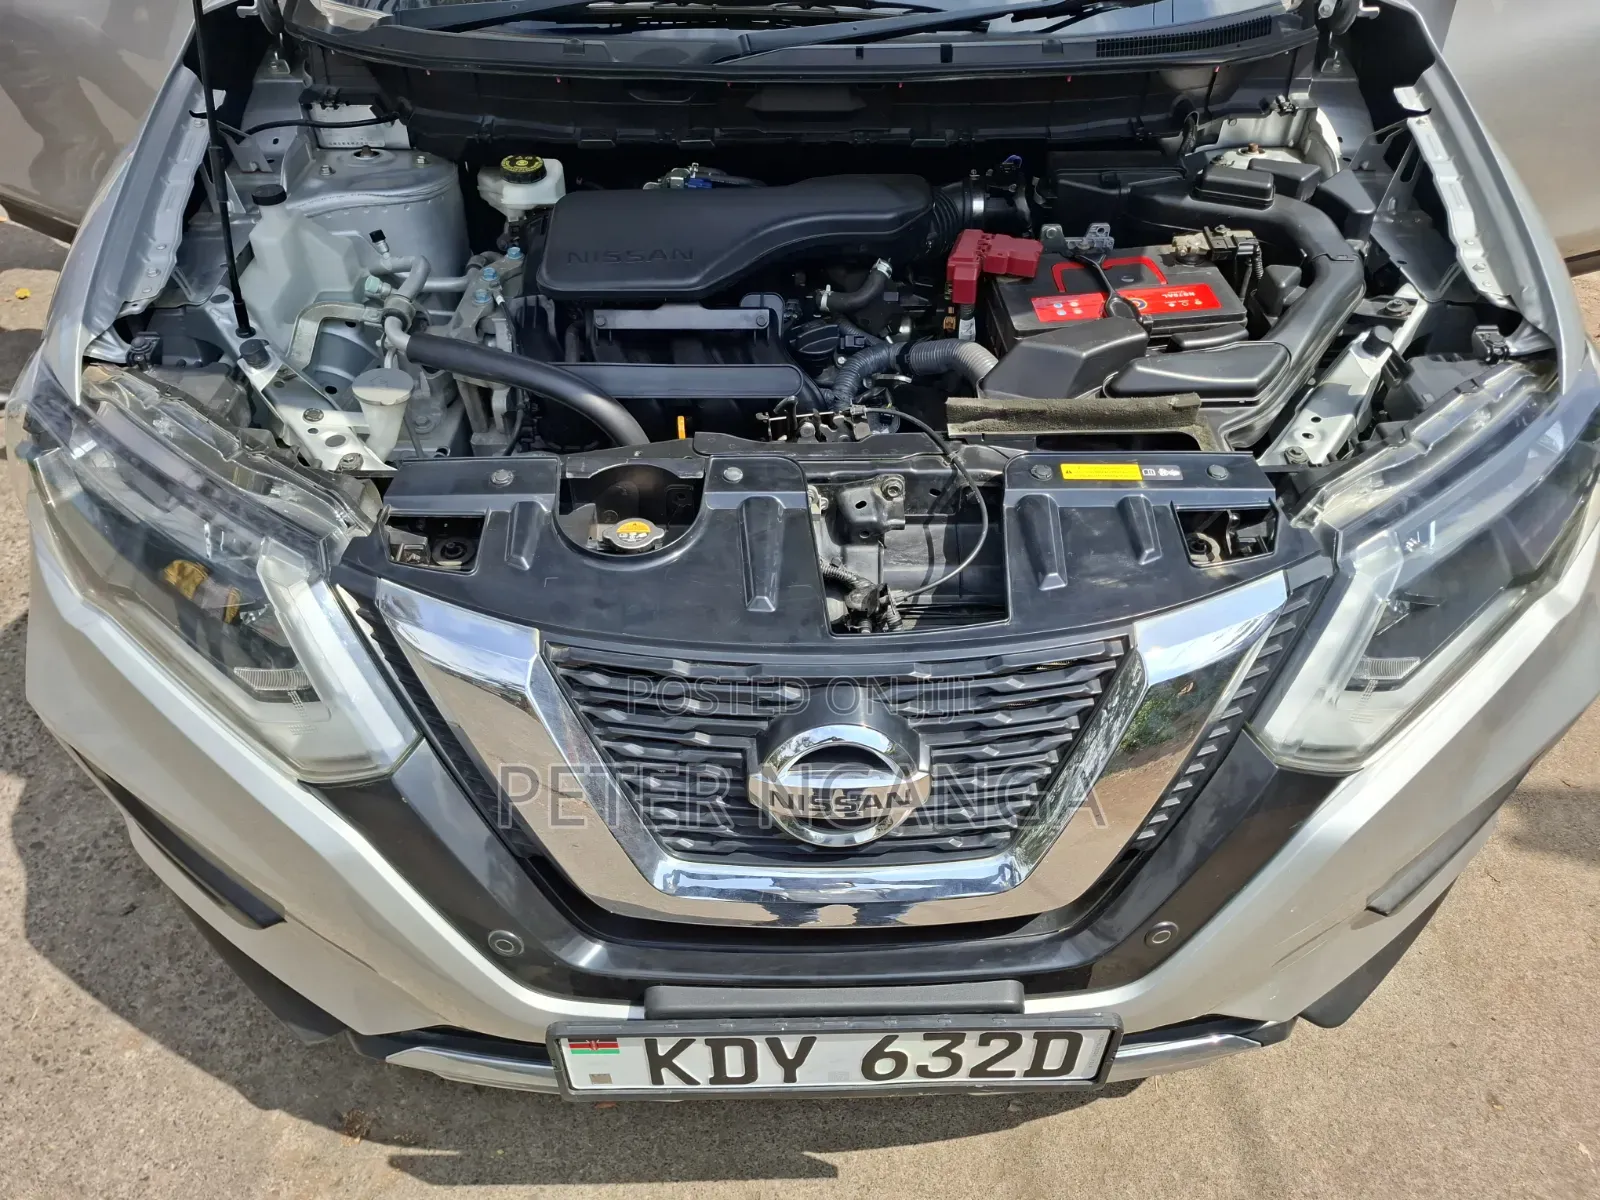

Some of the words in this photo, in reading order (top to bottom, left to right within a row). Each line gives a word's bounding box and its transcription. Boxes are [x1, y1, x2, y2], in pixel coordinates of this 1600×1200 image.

[567, 247, 694, 264] NISSAN
[770, 788, 911, 812] NISSAN
[644, 1036, 817, 1086] KDY
[861, 1031, 1083, 1081] 632D
